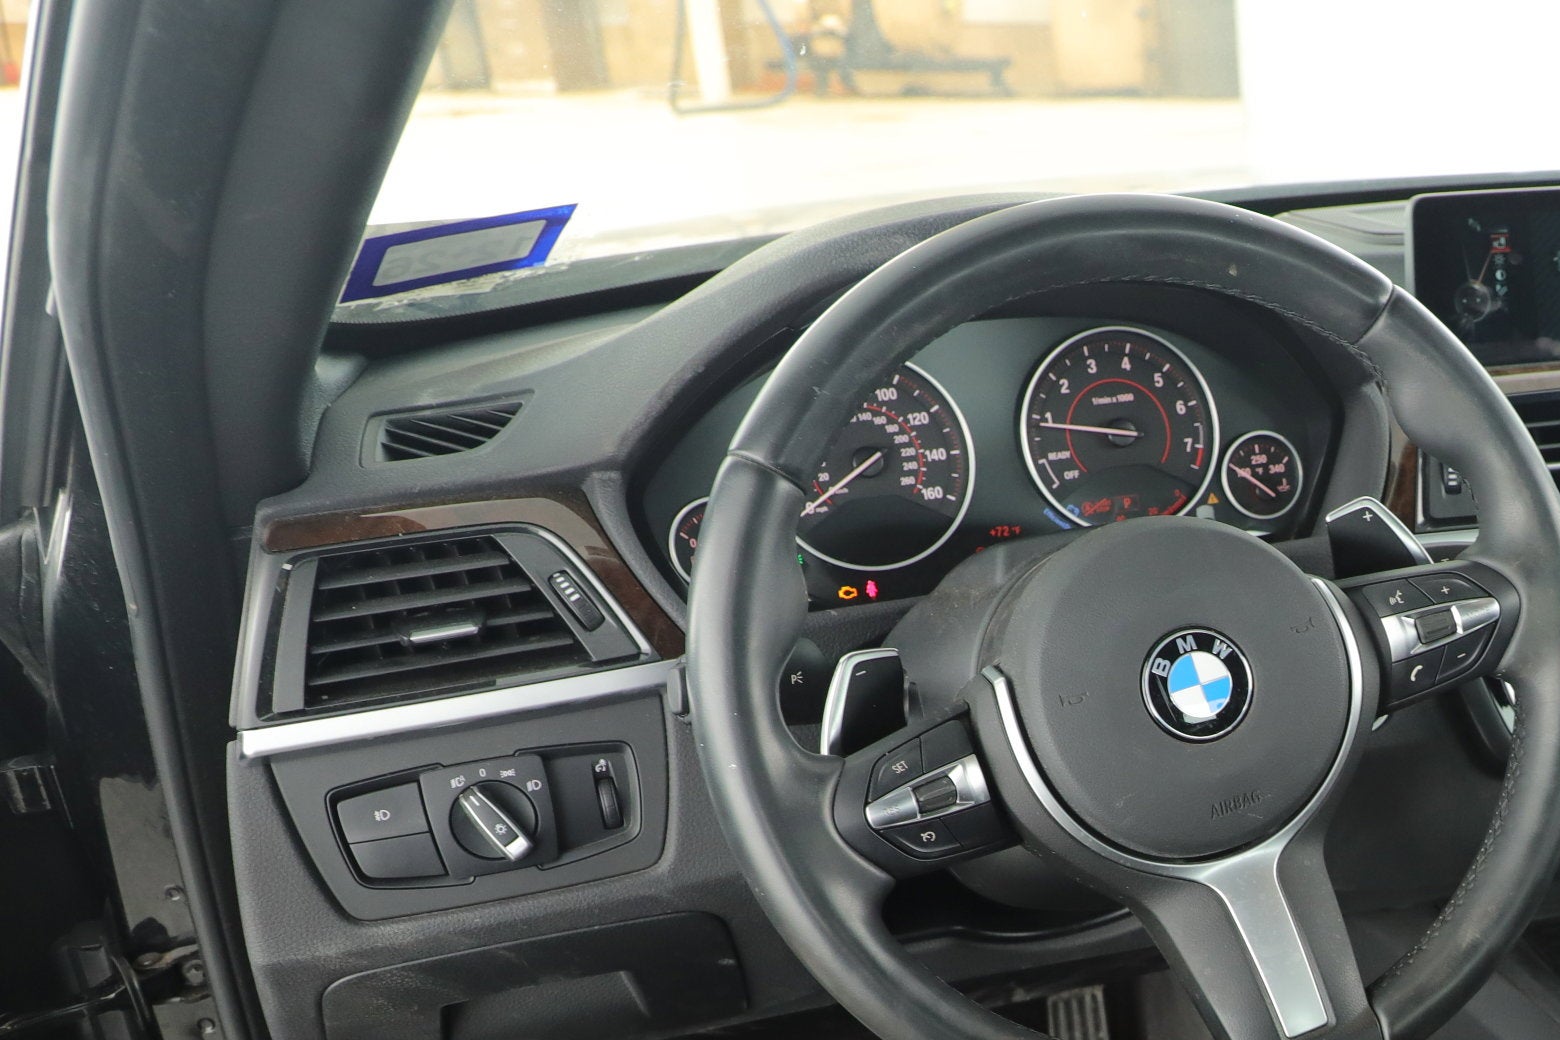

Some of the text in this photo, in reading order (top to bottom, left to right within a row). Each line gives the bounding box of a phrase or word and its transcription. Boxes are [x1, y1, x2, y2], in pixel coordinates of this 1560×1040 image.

[1086, 359, 1098, 374] 3
[1121, 356, 1132, 371] 4
[1058, 379, 1071, 394] 2
[1153, 372, 1164, 388] 5
[874, 387, 898, 401] 100
[1175, 400, 1187, 415] 6
[906, 411, 930, 426] 120
[1044, 411, 1053, 425] 1
[1183, 437, 1193, 453] 7
[924, 447, 947, 462] 140
[1047, 450, 1072, 461] READY
[817, 472, 830, 482] 20
[1063, 469, 1080, 480] OFF
[920, 486, 944, 501] 160
[1123, 496, 1133, 509] P
[1151, 634, 1233, 679] BMW
[478, 768, 487, 778] 0
[891, 760, 909, 775] SET
[1210, 789, 1264, 821] AIRBAG
